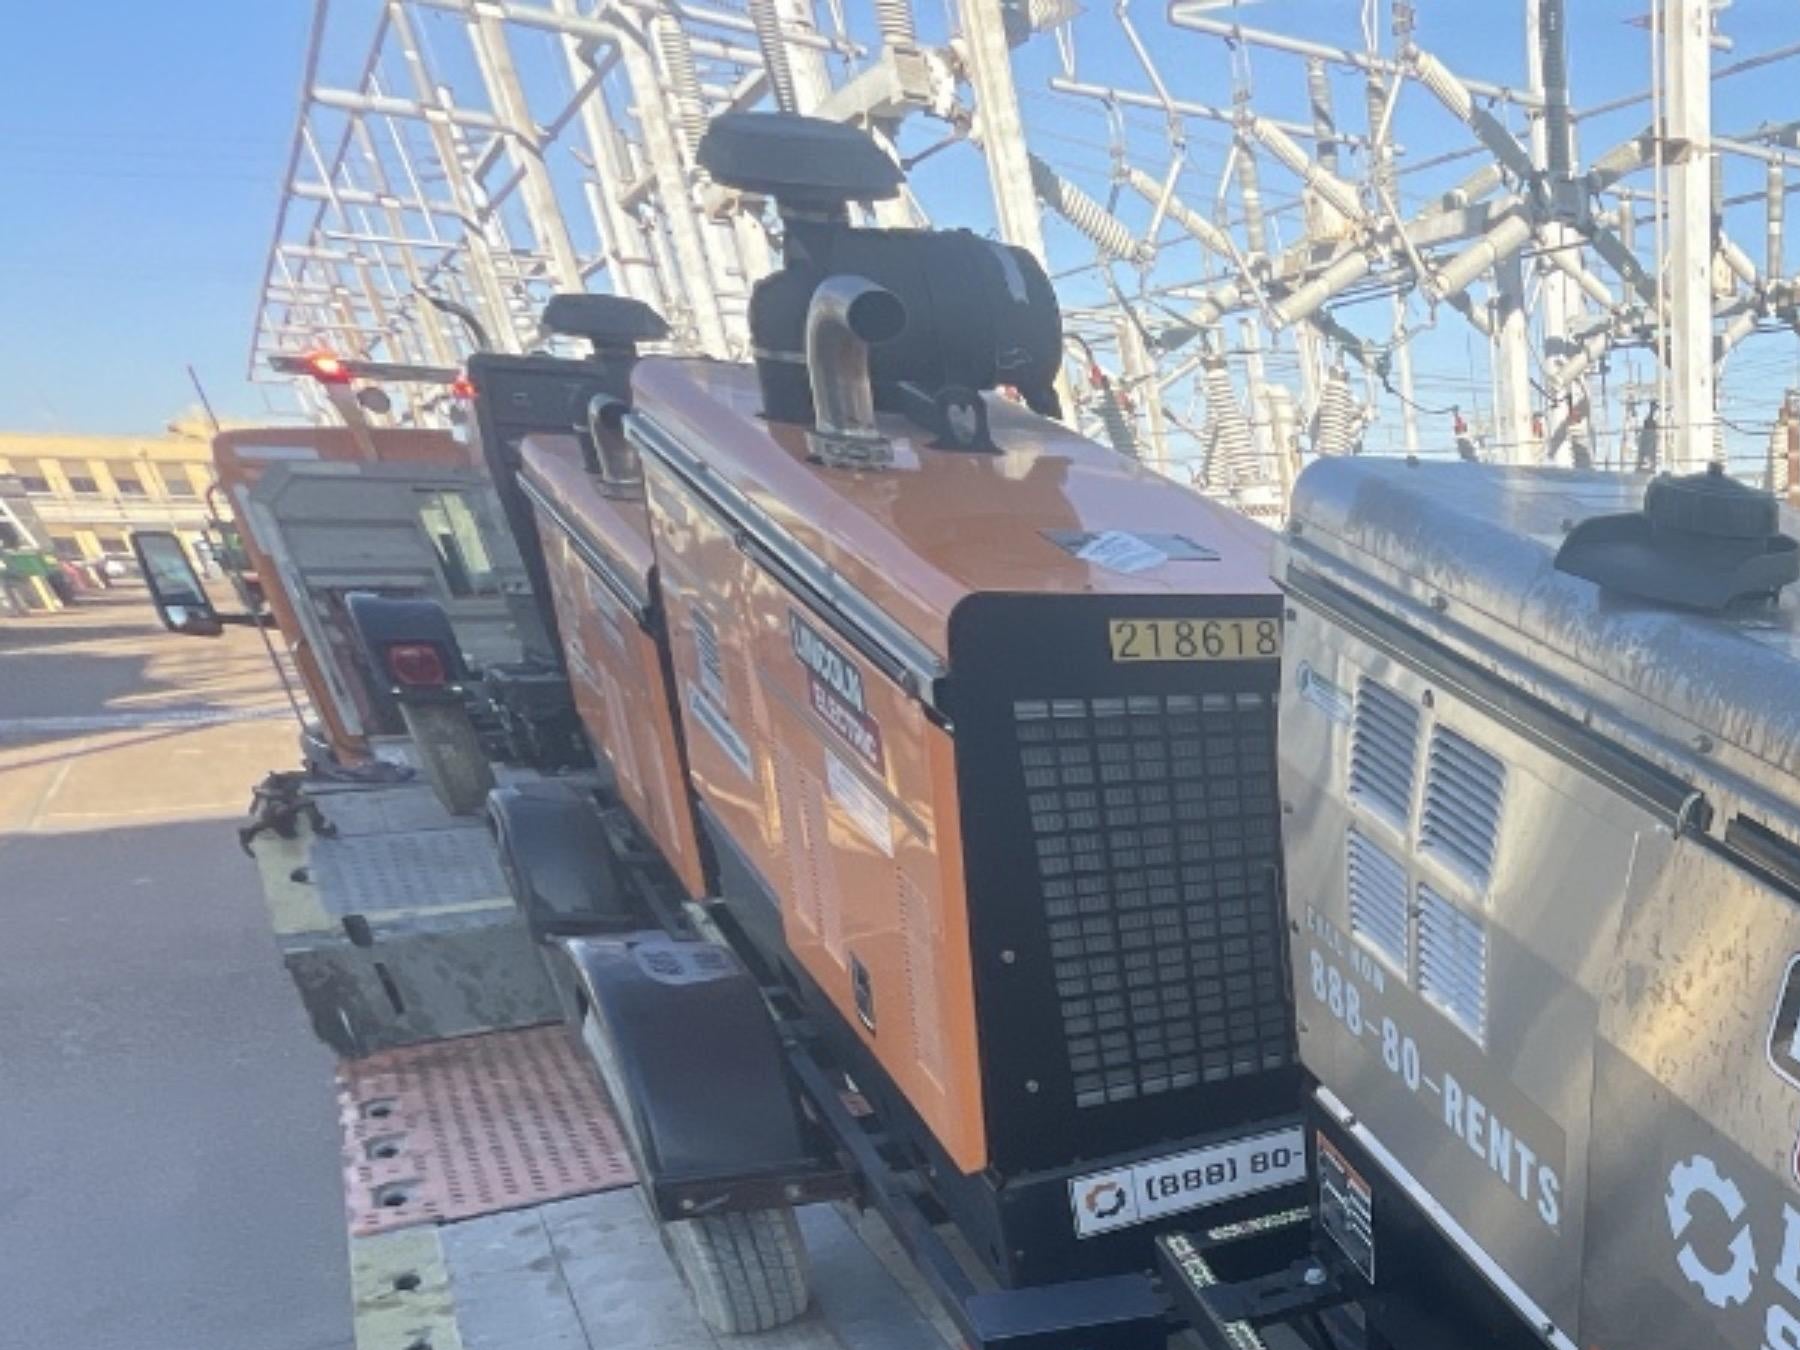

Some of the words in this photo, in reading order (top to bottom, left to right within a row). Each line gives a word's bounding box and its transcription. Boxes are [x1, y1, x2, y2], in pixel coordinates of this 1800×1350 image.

[1115, 620, 1276, 658] 218618
[1310, 948, 1561, 1228] 888-80-RENTS
[1145, 1157, 1238, 1201] (888)
